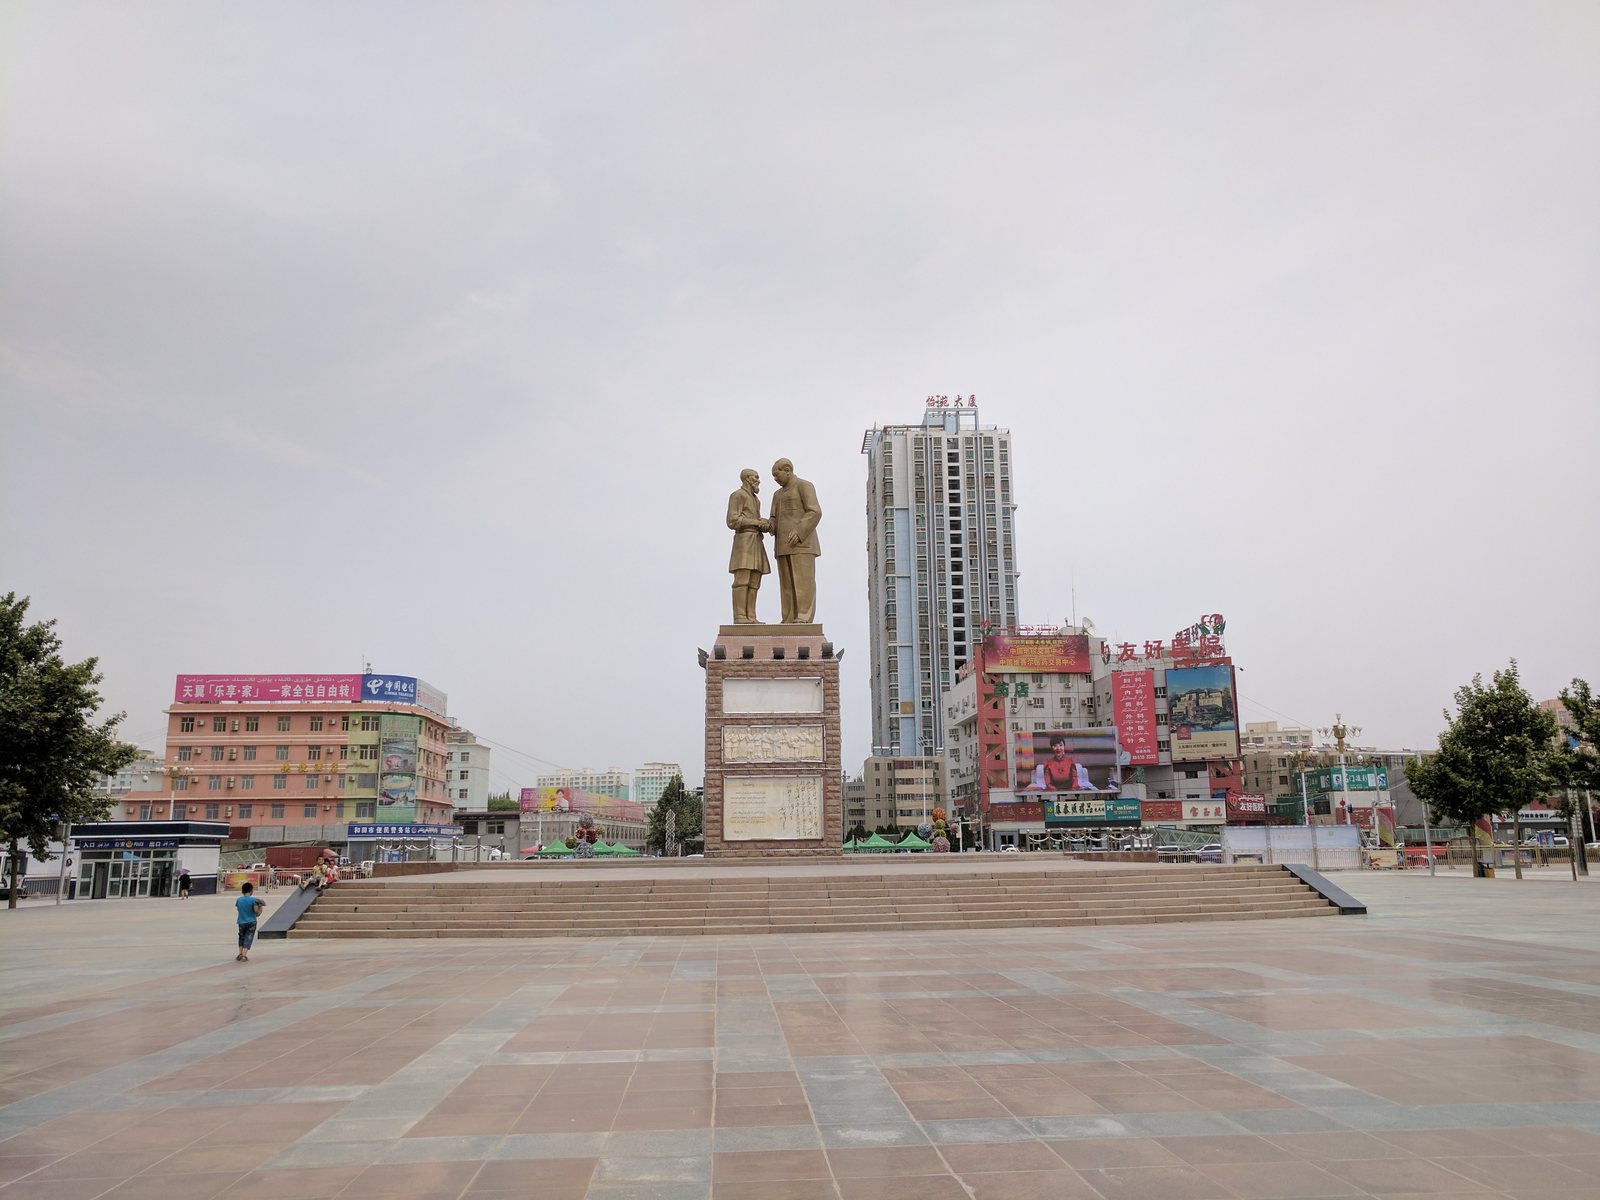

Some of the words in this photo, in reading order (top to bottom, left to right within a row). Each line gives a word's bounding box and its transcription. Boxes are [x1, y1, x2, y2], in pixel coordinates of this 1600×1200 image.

[1118, 635, 1224, 662] 友好医院
[385, 680, 414, 693] 中国电信
[993, 682, 1029, 698] 药店
[1239, 802, 1265, 812] 友好医院
